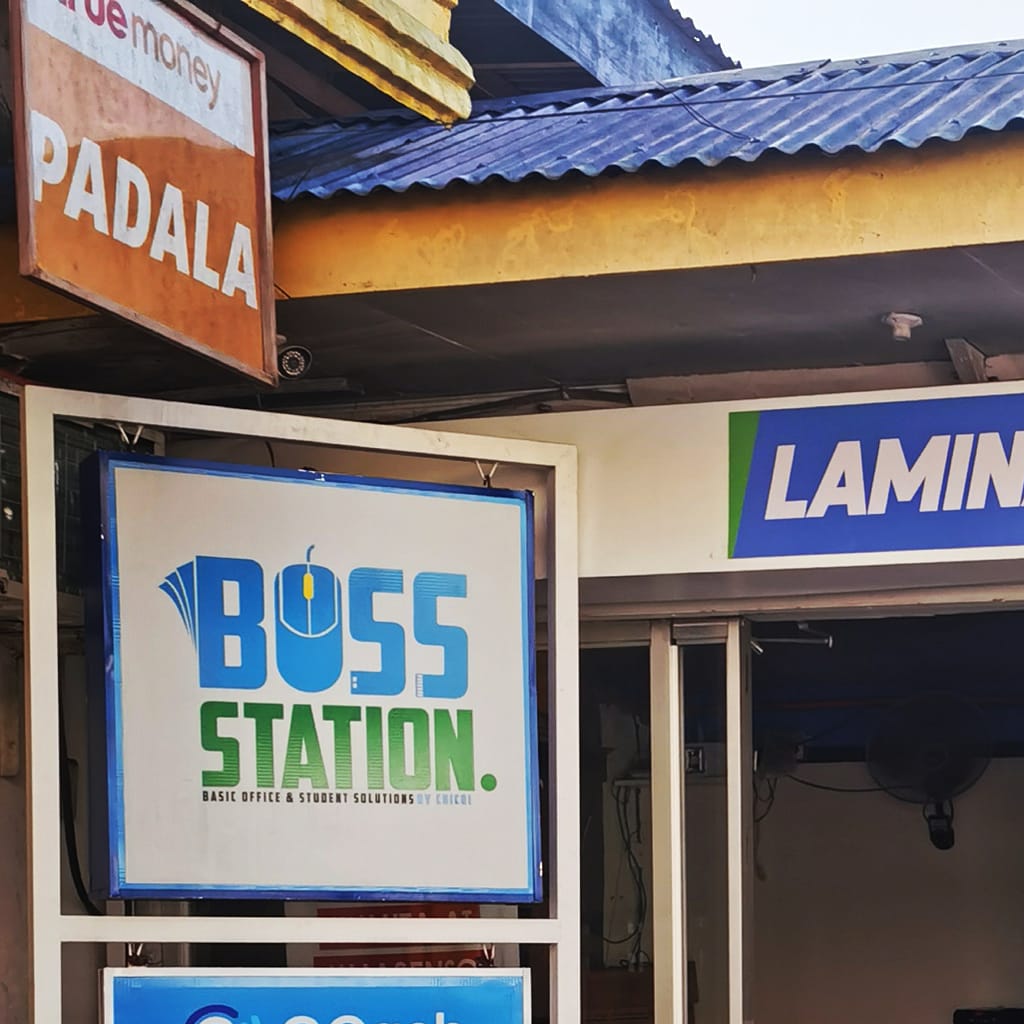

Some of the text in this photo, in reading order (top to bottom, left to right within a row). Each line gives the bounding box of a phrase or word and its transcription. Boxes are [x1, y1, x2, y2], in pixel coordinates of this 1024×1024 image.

[31, 108, 258, 309] PADALA
[194, 553, 469, 699] BOSS
[200, 701, 497, 792] STATION.
[202, 790, 236, 803] BASIC
[242, 791, 281, 803] OFFICE
[286, 792, 294, 804] &
[299, 792, 348, 804] STUDENT
[353, 793, 415, 805] SOLUTIONS
